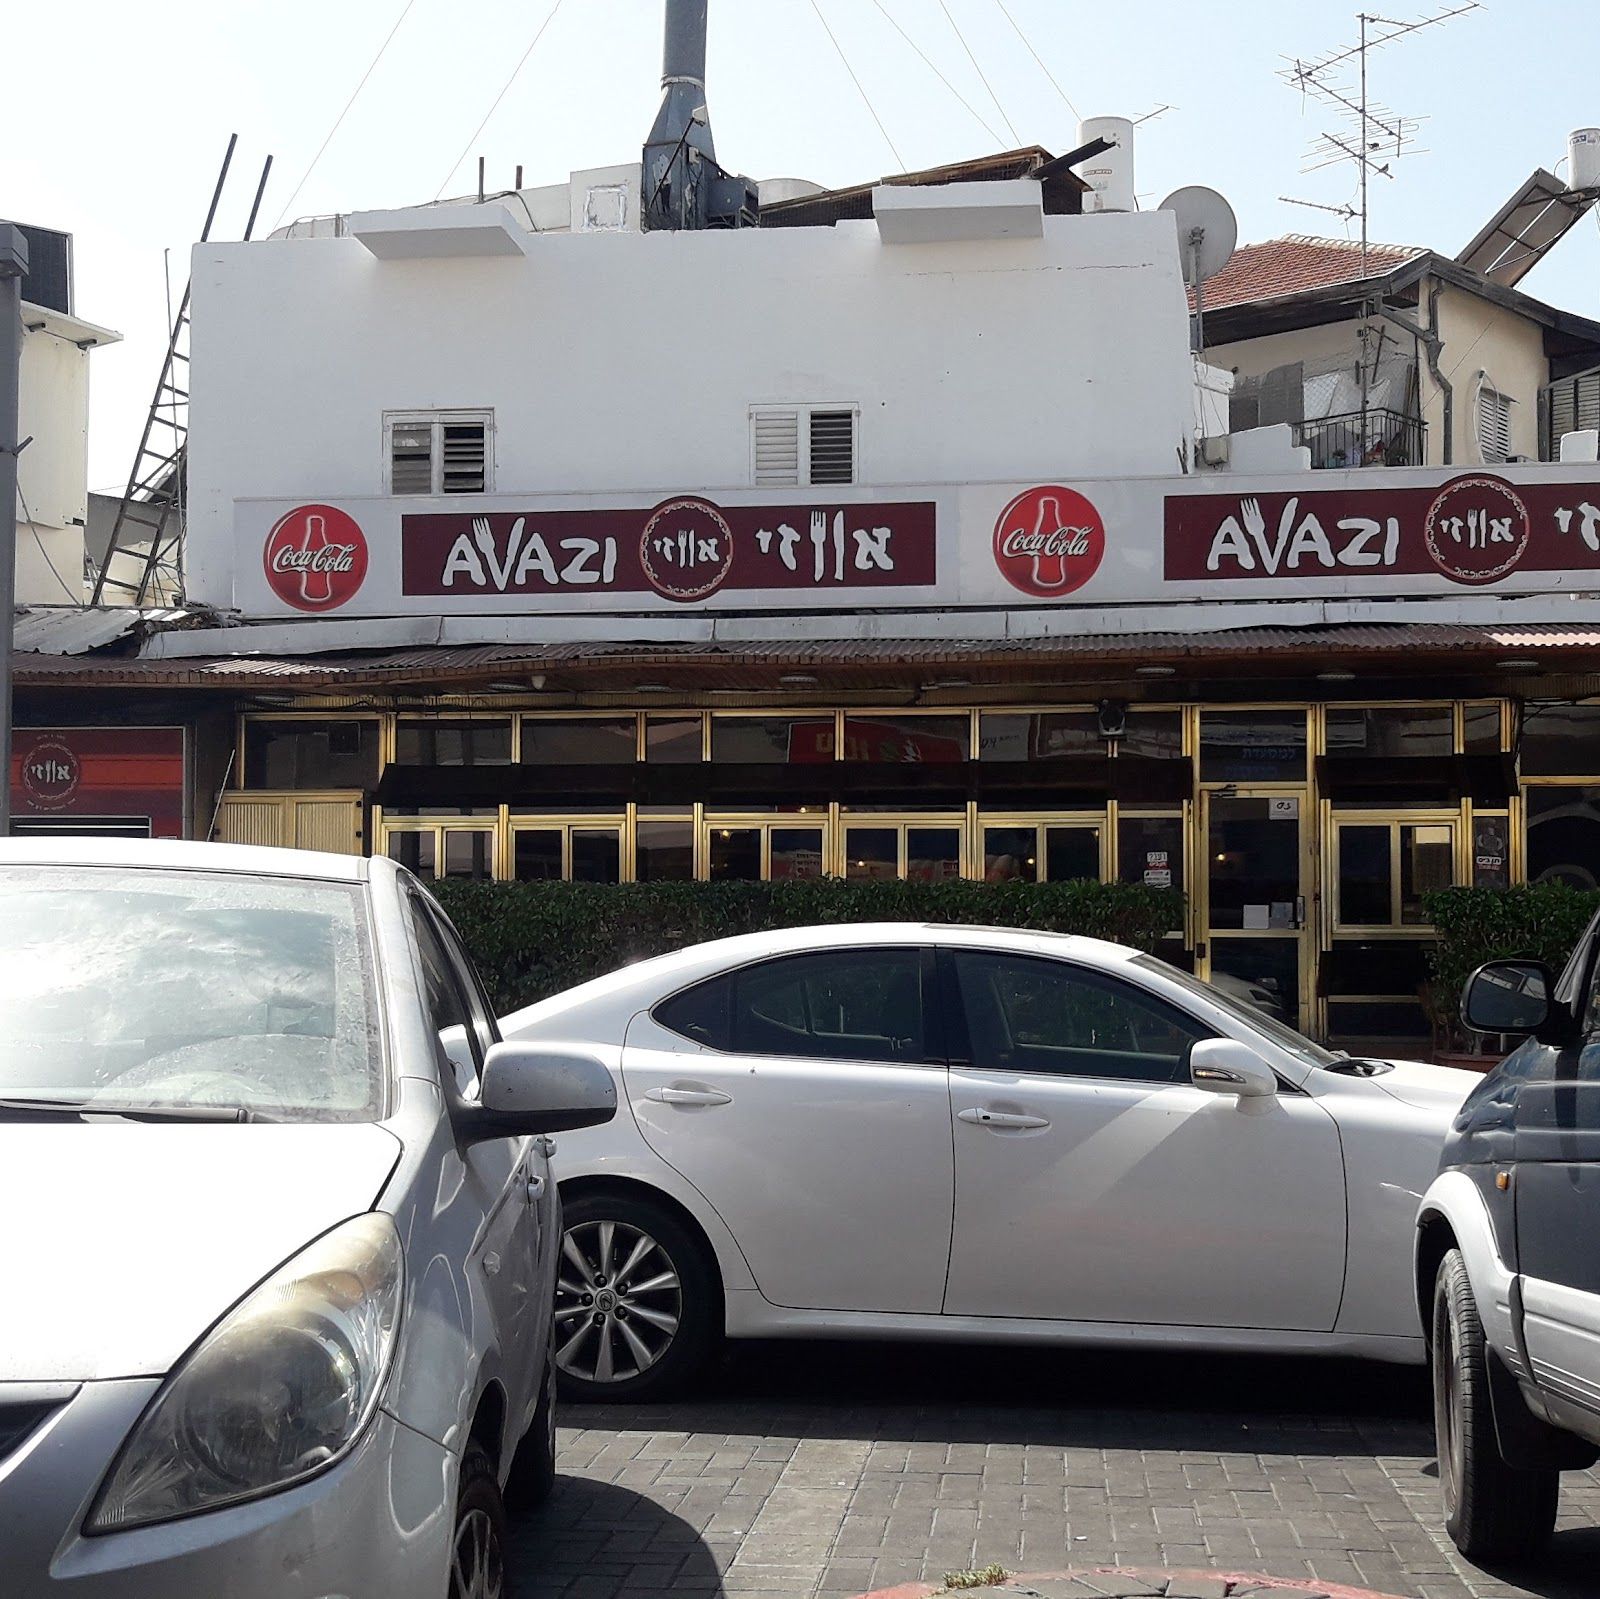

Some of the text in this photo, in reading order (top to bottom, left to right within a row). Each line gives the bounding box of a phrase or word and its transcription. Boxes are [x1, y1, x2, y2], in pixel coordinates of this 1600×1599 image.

[653, 529, 720, 568] אווזי
[755, 511, 894, 582] אווזי
[1002, 526, 1095, 558] Coca-Cola
[1206, 497, 1400, 575] AVAZI
[1439, 509, 1514, 549] אווזי
[273, 544, 359, 573] Coca-Cola
[442, 517, 617, 591] AVAZI
